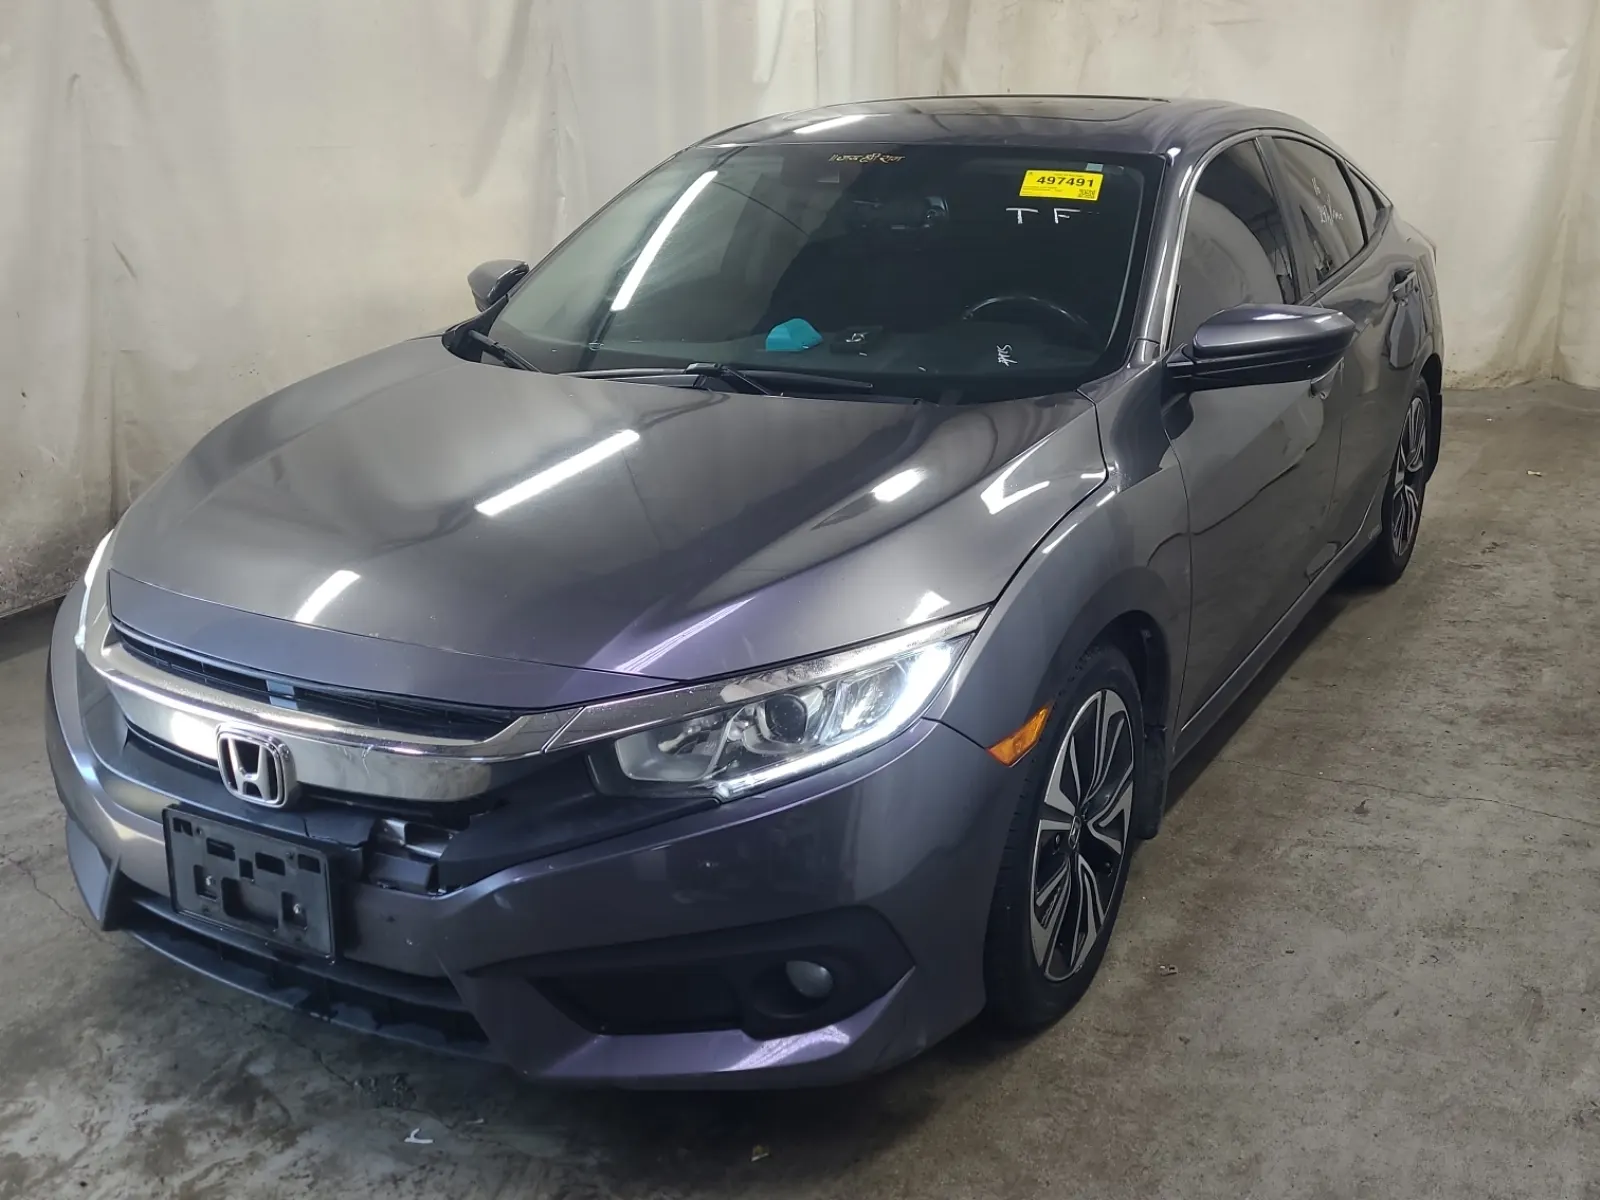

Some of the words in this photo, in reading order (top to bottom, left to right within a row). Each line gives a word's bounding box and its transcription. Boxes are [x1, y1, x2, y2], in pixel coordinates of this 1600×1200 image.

[1036, 176, 1095, 188] 497491
[1006, 207, 1039, 224] T
[1054, 207, 1081, 224] F
